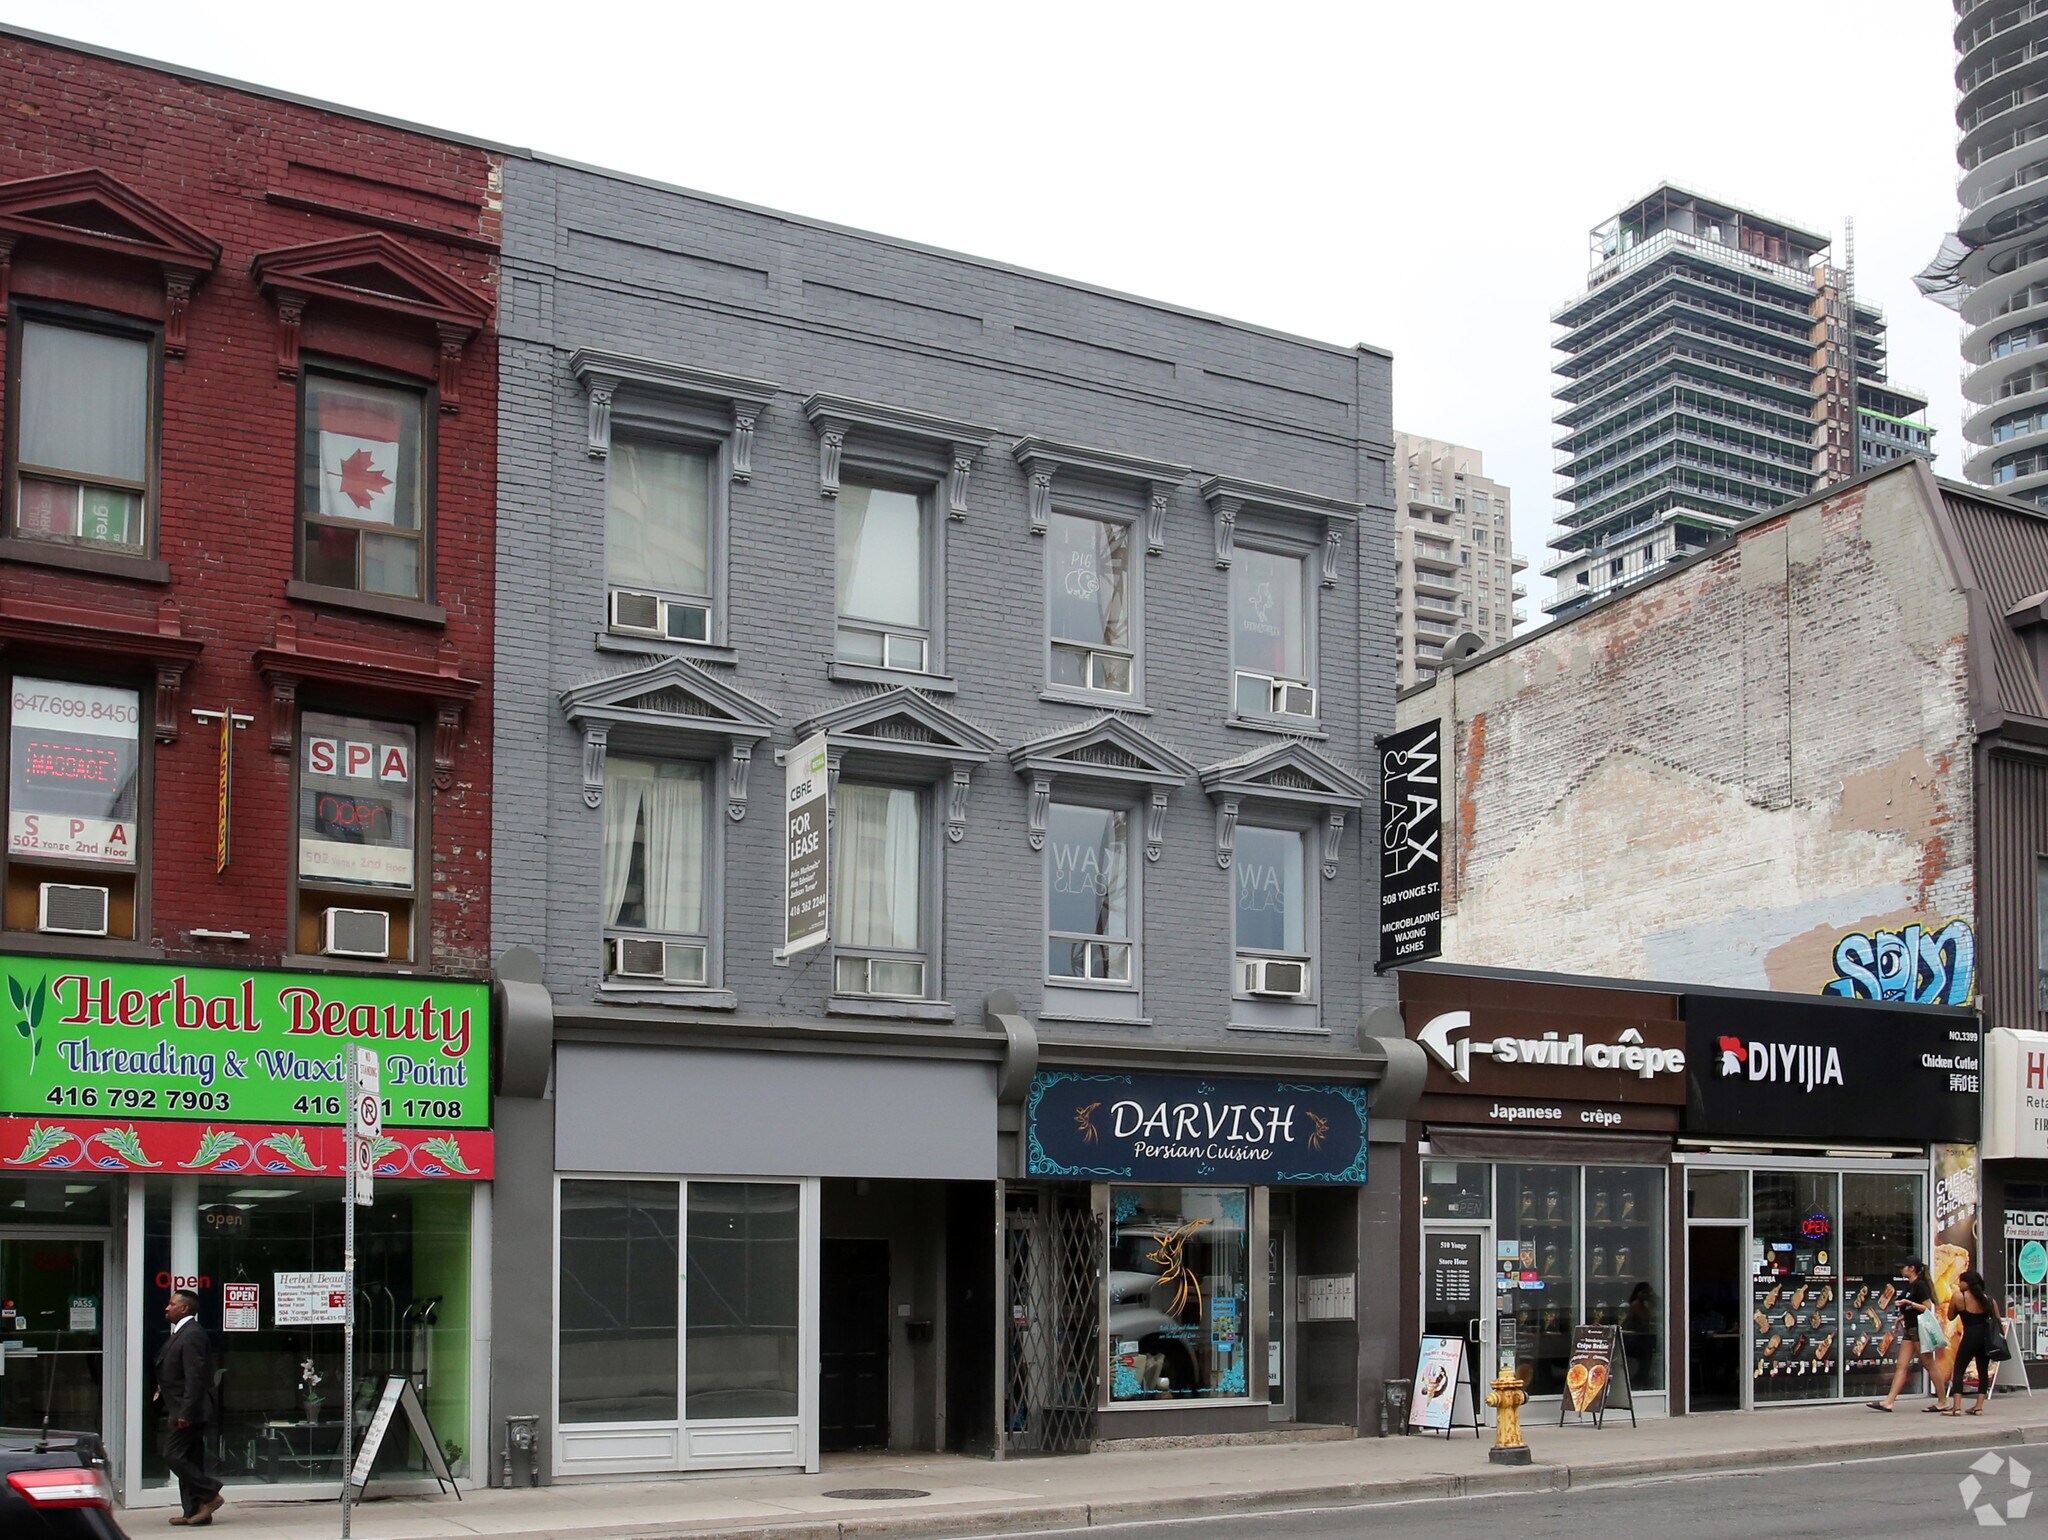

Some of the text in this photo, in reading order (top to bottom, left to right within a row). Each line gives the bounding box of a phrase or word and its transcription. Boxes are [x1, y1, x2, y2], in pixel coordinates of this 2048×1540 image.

[1071, 551, 1092, 568] PIG
[790, 780, 812, 802] CBRE
[1407, 731, 1438, 871] WAX
[791, 812, 811, 839] FOR
[13, 835, 128, 858] 502 Yonge 2nd Floor
[791, 831, 819, 861] LEASE
[305, 851, 329, 864] 502
[360, 857, 381, 868] 2nd
[386, 862, 408, 873] Floor
[1382, 881, 1440, 906] 508 YONGE ST.
[790, 904, 801, 917] 416
[812, 894, 825, 909] 2244
[1382, 910, 1440, 934] MICROBLADING
[1395, 927, 1426, 943] WAXING
[1396, 940, 1424, 956] LASHES
[52, 974, 471, 1057] Herbal Beauty
[1949, 1030, 1978, 1042] NO.3399
[57, 1036, 216, 1086] Threading
[223, 1049, 248, 1079] &
[386, 1054, 468, 1088] Point
[1585, 1028, 1686, 1079] crêpe
[1922, 1053, 1978, 1071] Chicken Cutlet
[360, 1064, 378, 1078] STANDING
[1749, 1041, 1844, 1093] DIYIJIA
[46, 1086, 97, 1107] 416
[107, 1088, 156, 1109] 792
[165, 1090, 230, 1111] 7903
[293, 1096, 341, 1115] 416
[402, 1099, 462, 1119] 1708
[1110, 1099, 1296, 1144] DARVISH
[1489, 1104, 1622, 1127] Japanese crêpe
[1134, 1140, 1273, 1162] Persian Cuisine
[1936, 1165, 1975, 1195] CHEES
[1936, 1178, 1975, 1207] PLOSION
[1936, 1190, 1975, 1218] CHICKEN
[206, 1213, 243, 1227] open
[1802, 1220, 1829, 1233] OPEN
[1440, 1241, 1467, 1251] 510 Yonge
[155, 1272, 212, 1291] Open
[280, 1274, 312, 1284] Herbal
[73, 1300, 93, 1308] PASS
[229, 1291, 255, 1301] OPEN
